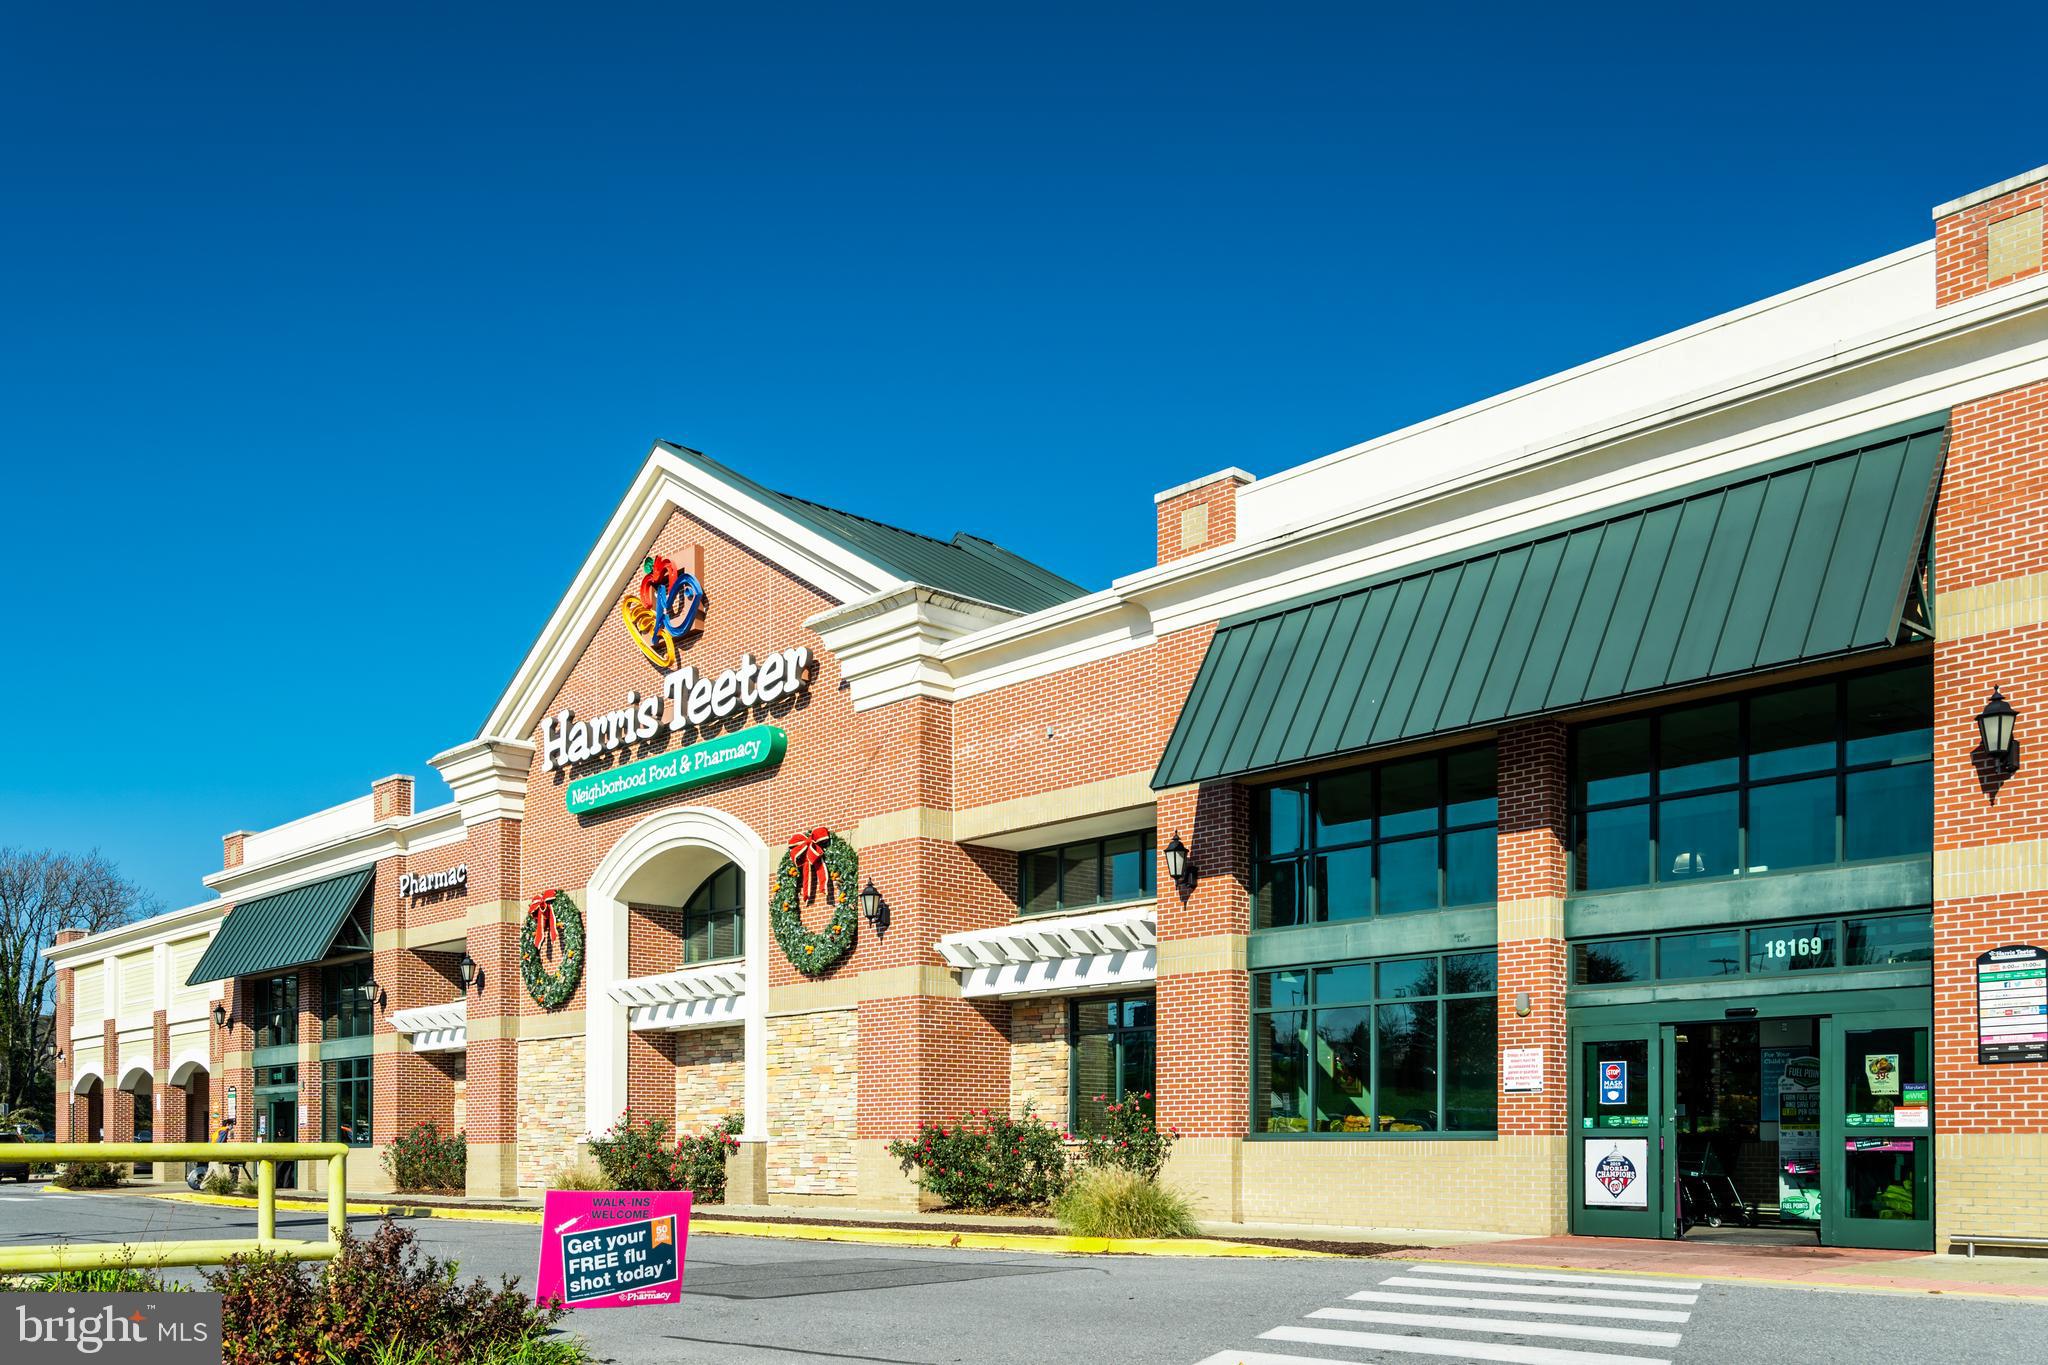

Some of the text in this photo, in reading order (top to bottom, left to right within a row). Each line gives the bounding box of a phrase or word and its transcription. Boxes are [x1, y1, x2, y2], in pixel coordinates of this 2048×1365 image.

[541, 646, 811, 772] Harris Teeter
[572, 739, 762, 806] Neighborhood Food & Pharmacy
[399, 863, 468, 899] Pharmac
[1764, 936, 1822, 959] 18169
[1997, 950, 2016, 958] Harris
[1788, 1067, 1820, 1079] FUEL POIN
[1596, 1170, 1636, 1180] CHAMPIONS
[1602, 1164, 1629, 1172] WORLD
[592, 1197, 651, 1207] WALK-INS
[591, 1209, 650, 1219] WELCOME
[567, 1229, 647, 1255] Get your
[569, 1248, 647, 1275] FREE flu
[569, 1272, 611, 1293] shot
[627, 1291, 671, 1302] Pharmacy
